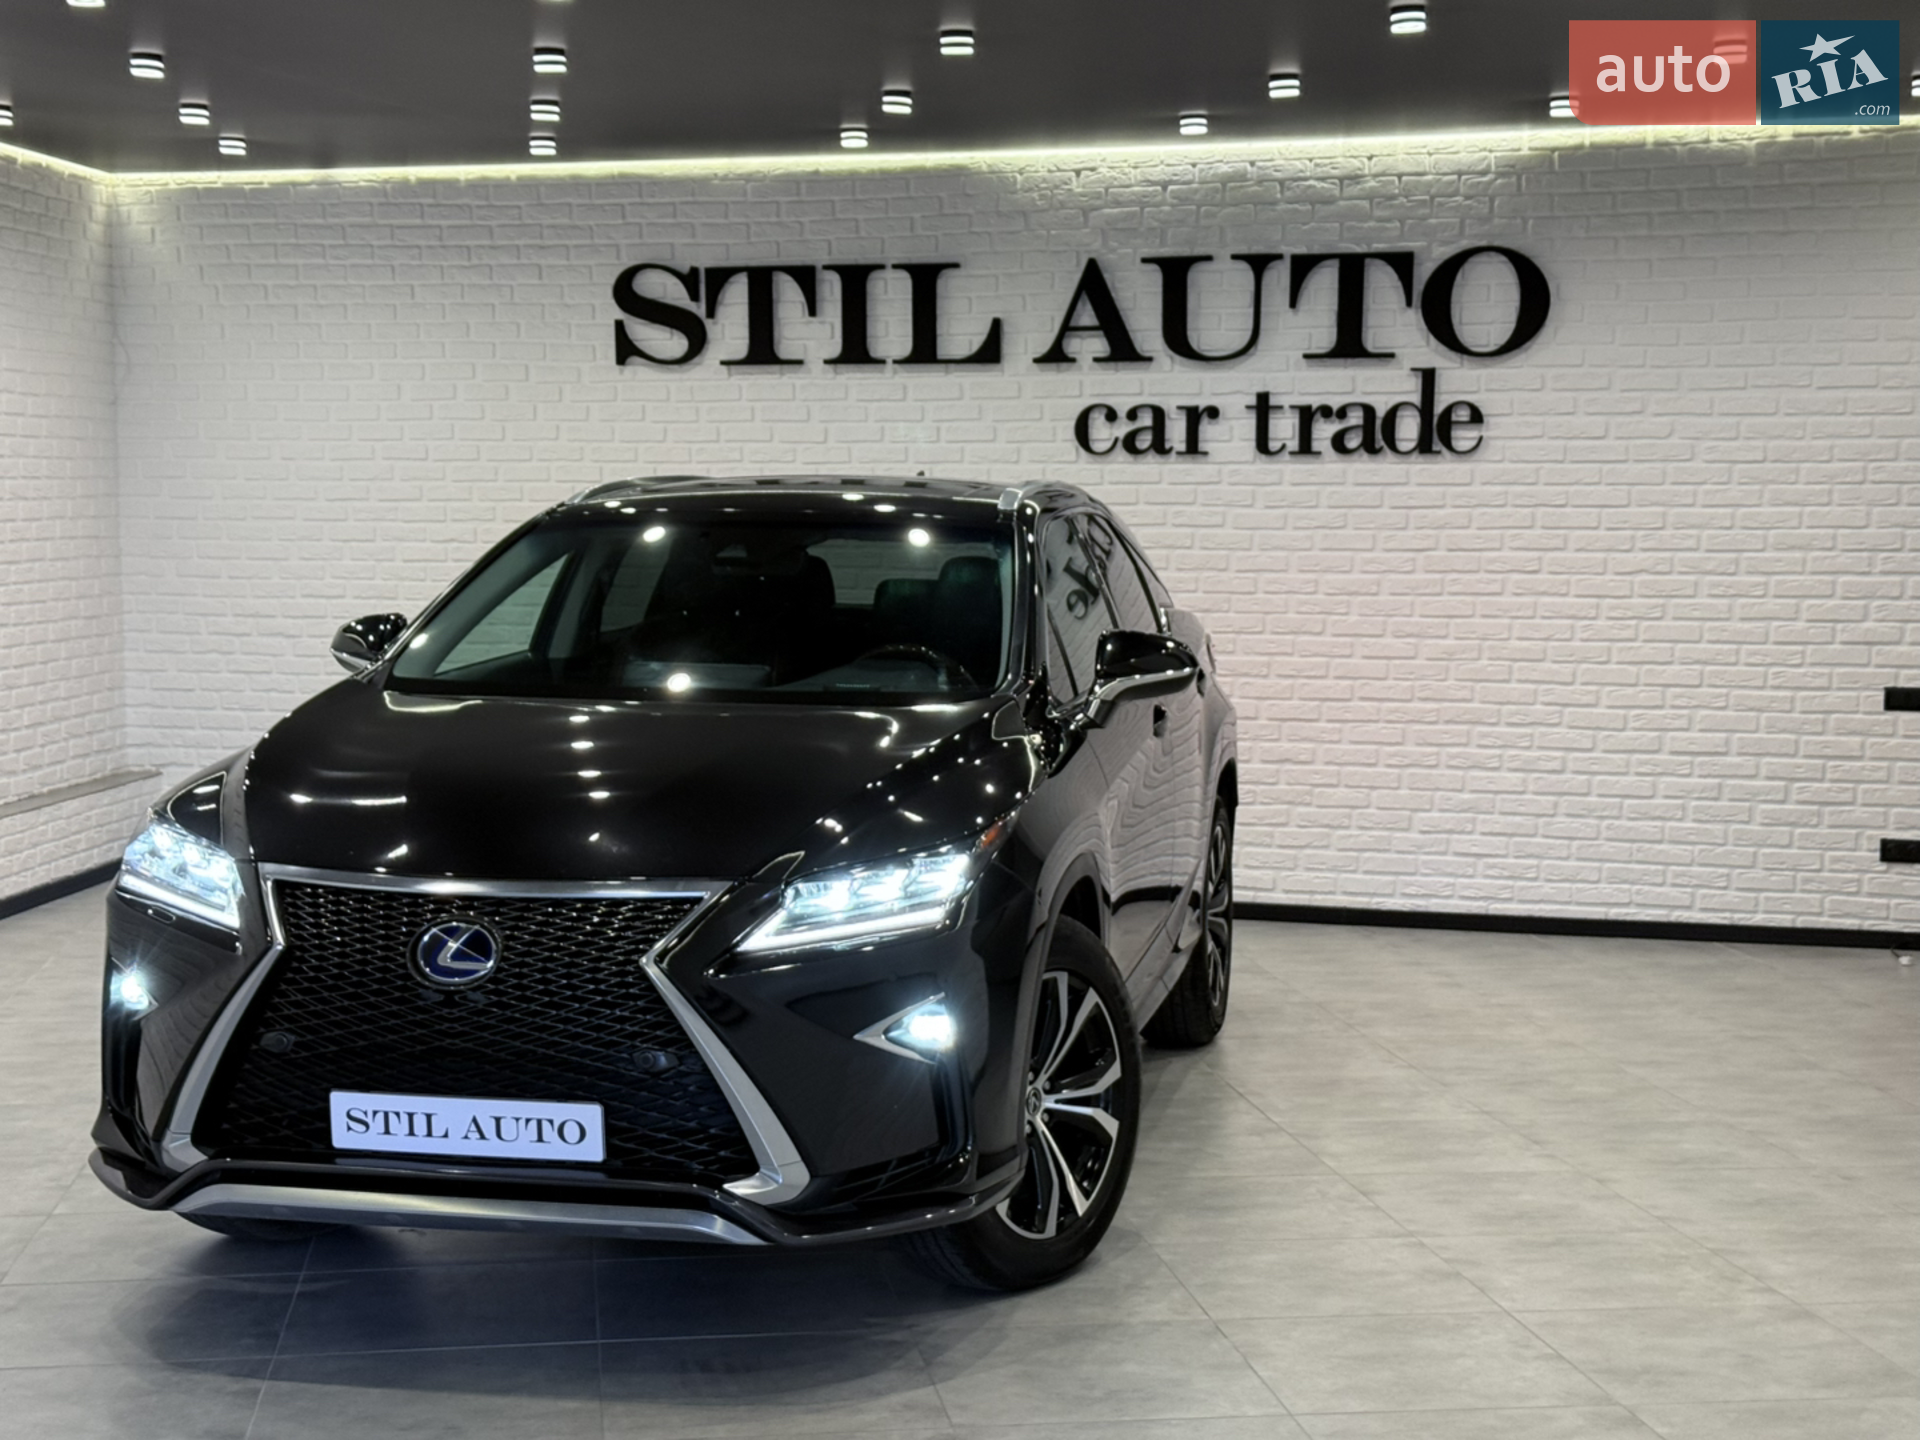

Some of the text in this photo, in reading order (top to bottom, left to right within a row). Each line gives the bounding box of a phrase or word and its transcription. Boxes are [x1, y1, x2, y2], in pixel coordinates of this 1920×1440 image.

[611, 245, 1552, 367] STIL AUTO
[1074, 367, 1486, 457] car trade
[346, 1107, 587, 1145] STIL AUTO
